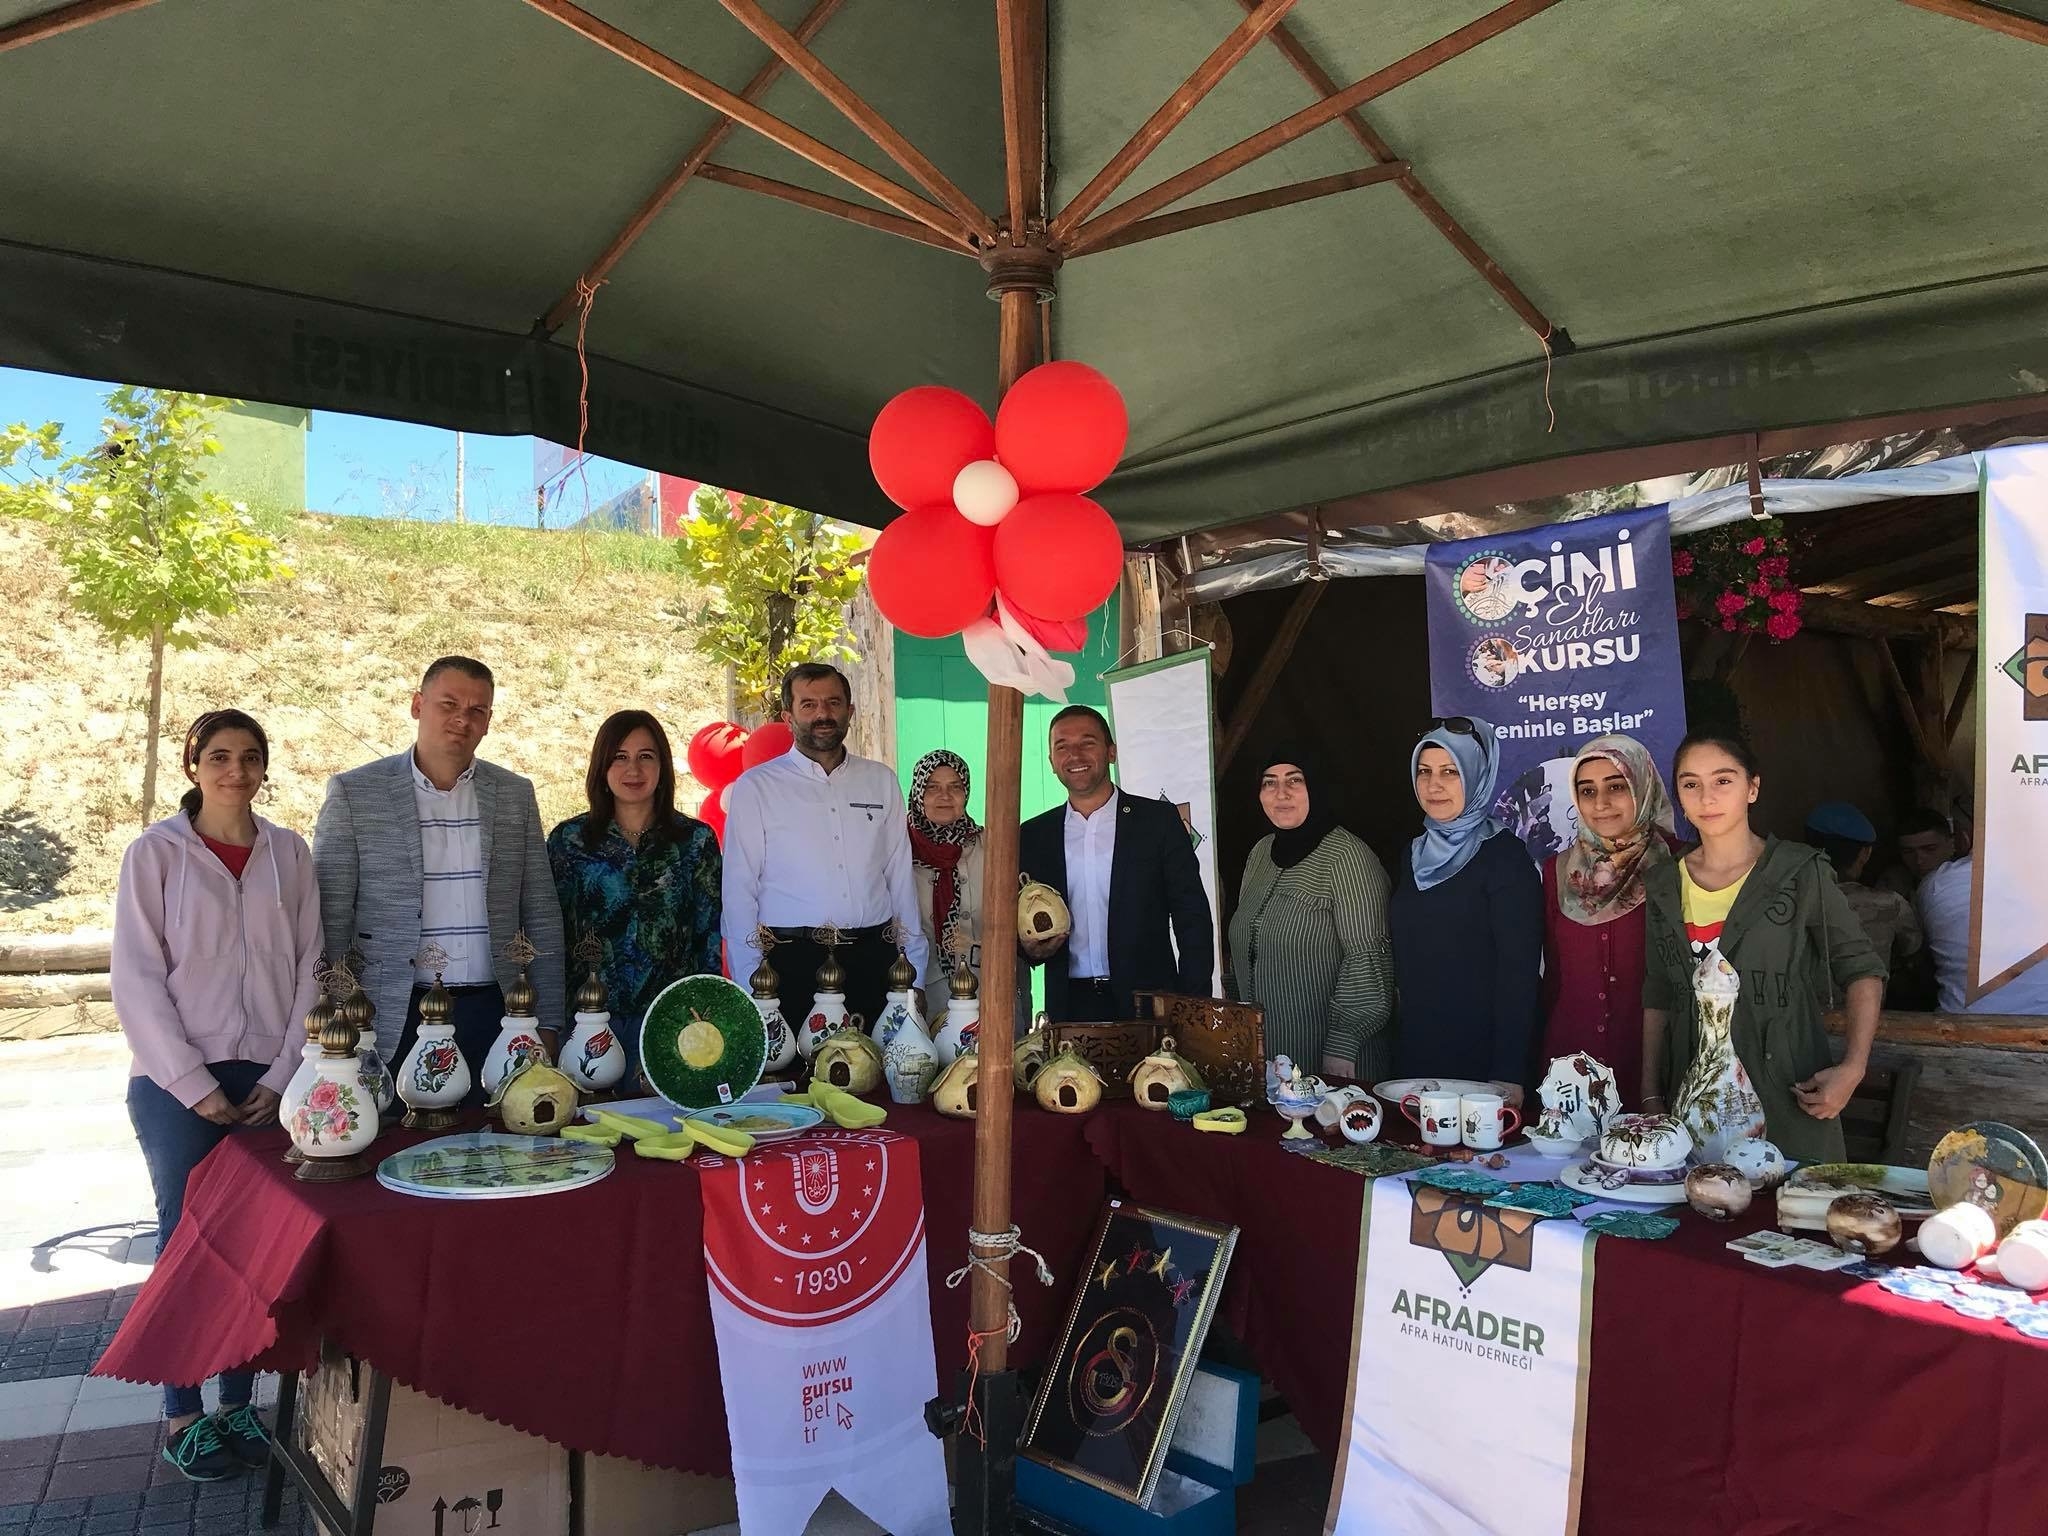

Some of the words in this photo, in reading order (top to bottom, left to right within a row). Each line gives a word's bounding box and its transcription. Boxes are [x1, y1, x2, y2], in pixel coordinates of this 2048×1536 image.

[1513, 529, 1637, 618] ÇİNİ
[1546, 575, 1603, 626] El
[1513, 607, 1641, 652] Sanatları
[1518, 634, 1640, 674] KURSU
[1489, 719, 1567, 740] eninle
[794, 1260, 852, 1295] 1930
[1391, 1288, 1545, 1356] AFRADER
[1400, 1322, 1429, 1341] AFRA
[1432, 1331, 1473, 1354] HATUN
[1477, 1344, 1533, 1372] DERNEĞİ
[802, 1356, 847, 1380] www
[802, 1377, 853, 1406] gursu
[804, 1398, 830, 1422] bel
[804, 1426, 818, 1443] tr
